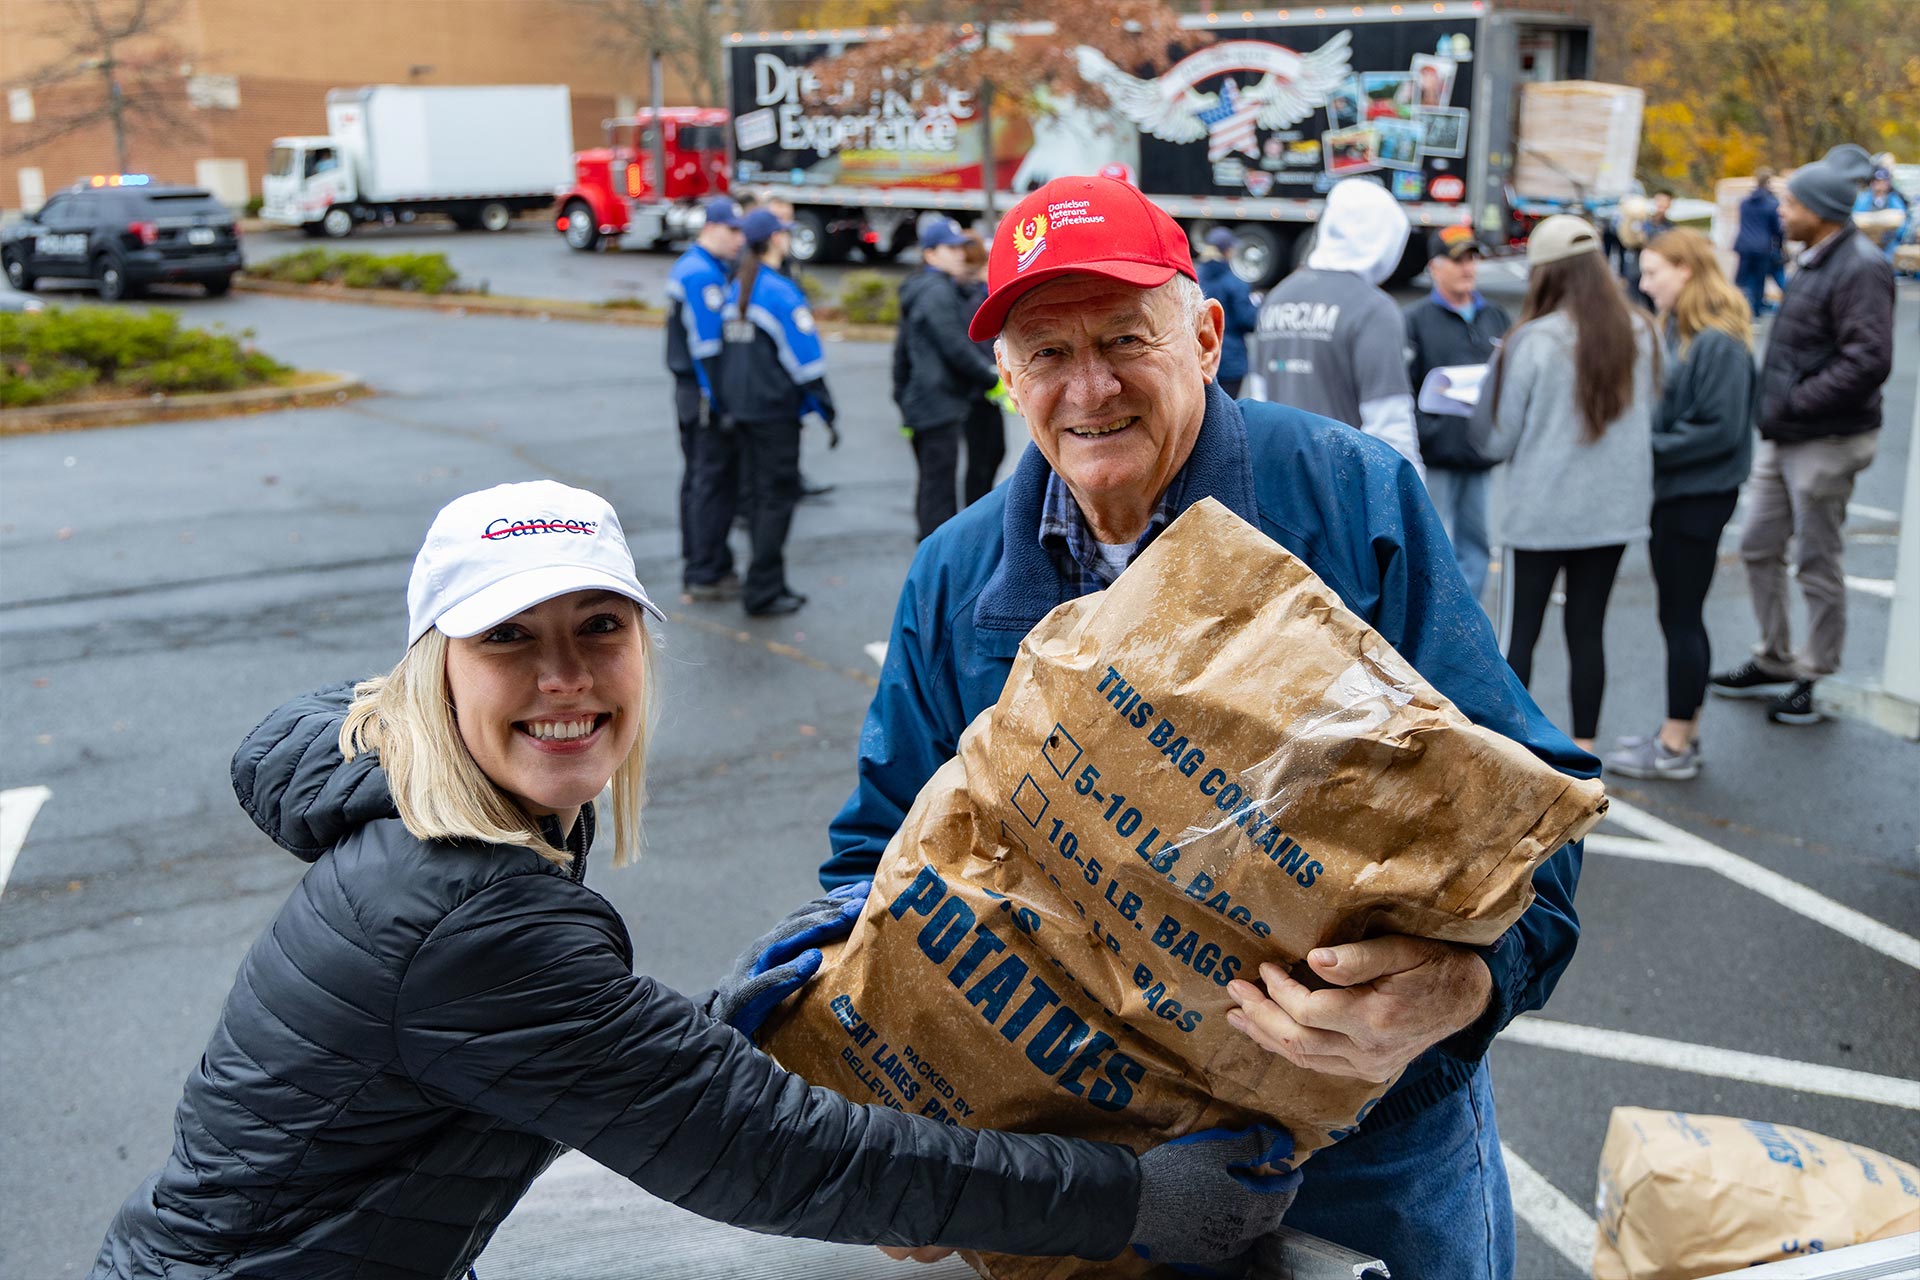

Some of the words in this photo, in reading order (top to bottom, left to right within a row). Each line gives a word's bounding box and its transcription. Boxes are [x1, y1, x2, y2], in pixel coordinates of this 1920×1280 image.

[780, 103, 958, 158] Experience
[1048, 200, 1090, 212] Danielson
[1049, 208, 1087, 220] Veterans
[1051, 215, 1105, 230] Coffeehouse
[485, 518, 596, 541] Cancer
[1096, 665, 1154, 729] THIS
[1148, 718, 1205, 778] BAG
[1200, 768, 1324, 888] CONTAINS
[1074, 764, 1143, 838] 5-10
[1135, 827, 1181, 883] LB.
[1184, 871, 1271, 939] BAGS
[1048, 817, 1103, 885] 10-5
[1104, 879, 1143, 931] LB.
[1151, 915, 1242, 987] BAGS
[888, 863, 1147, 1113] POTATOES
[1132, 962, 1203, 1033] BAGS
[830, 994, 878, 1048] GREAT
[871, 1043, 921, 1102] LAKES
[903, 1045, 954, 1099] PACKED
[953, 1097, 974, 1118] BY
